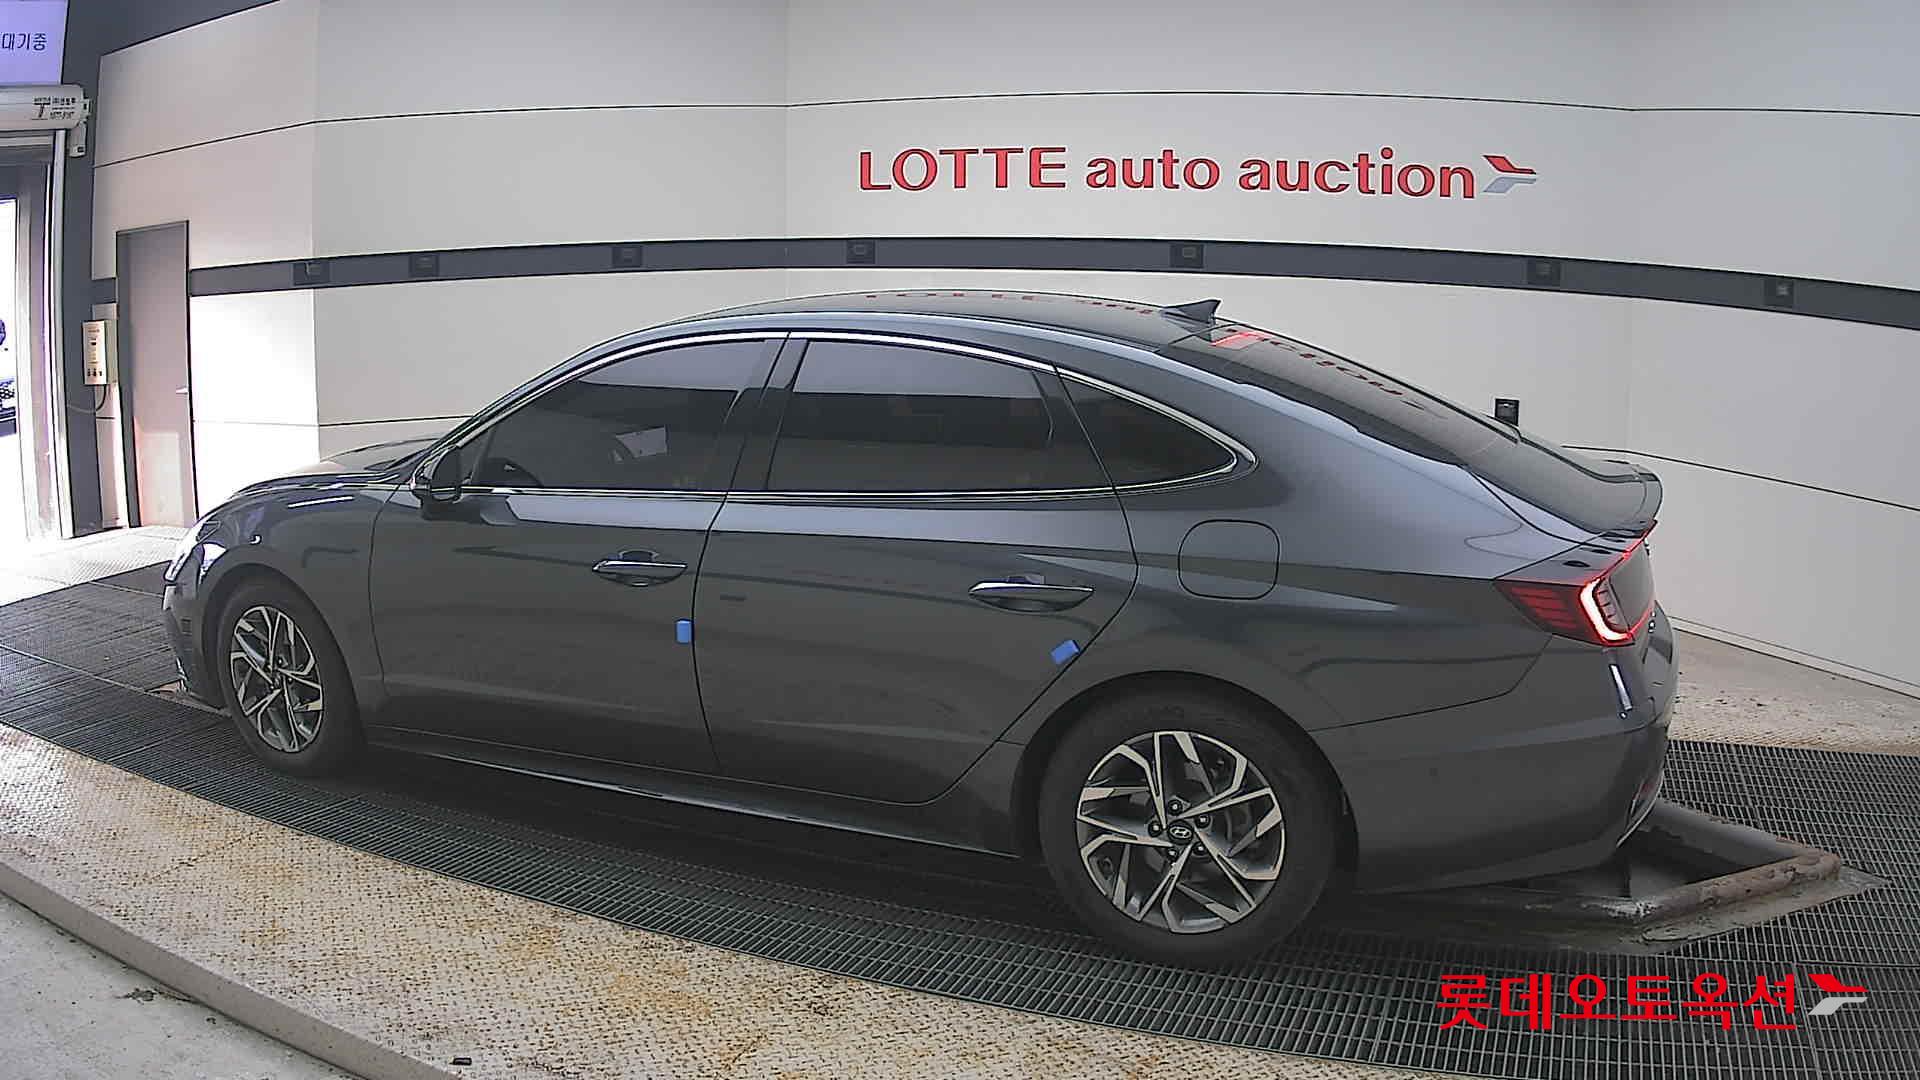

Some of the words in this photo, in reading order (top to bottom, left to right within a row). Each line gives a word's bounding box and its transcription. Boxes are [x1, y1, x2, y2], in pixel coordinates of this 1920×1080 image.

[859, 147, 1066, 191] LOTTE
[1086, 149, 1221, 190] auto
[1239, 148, 1475, 199] auction
